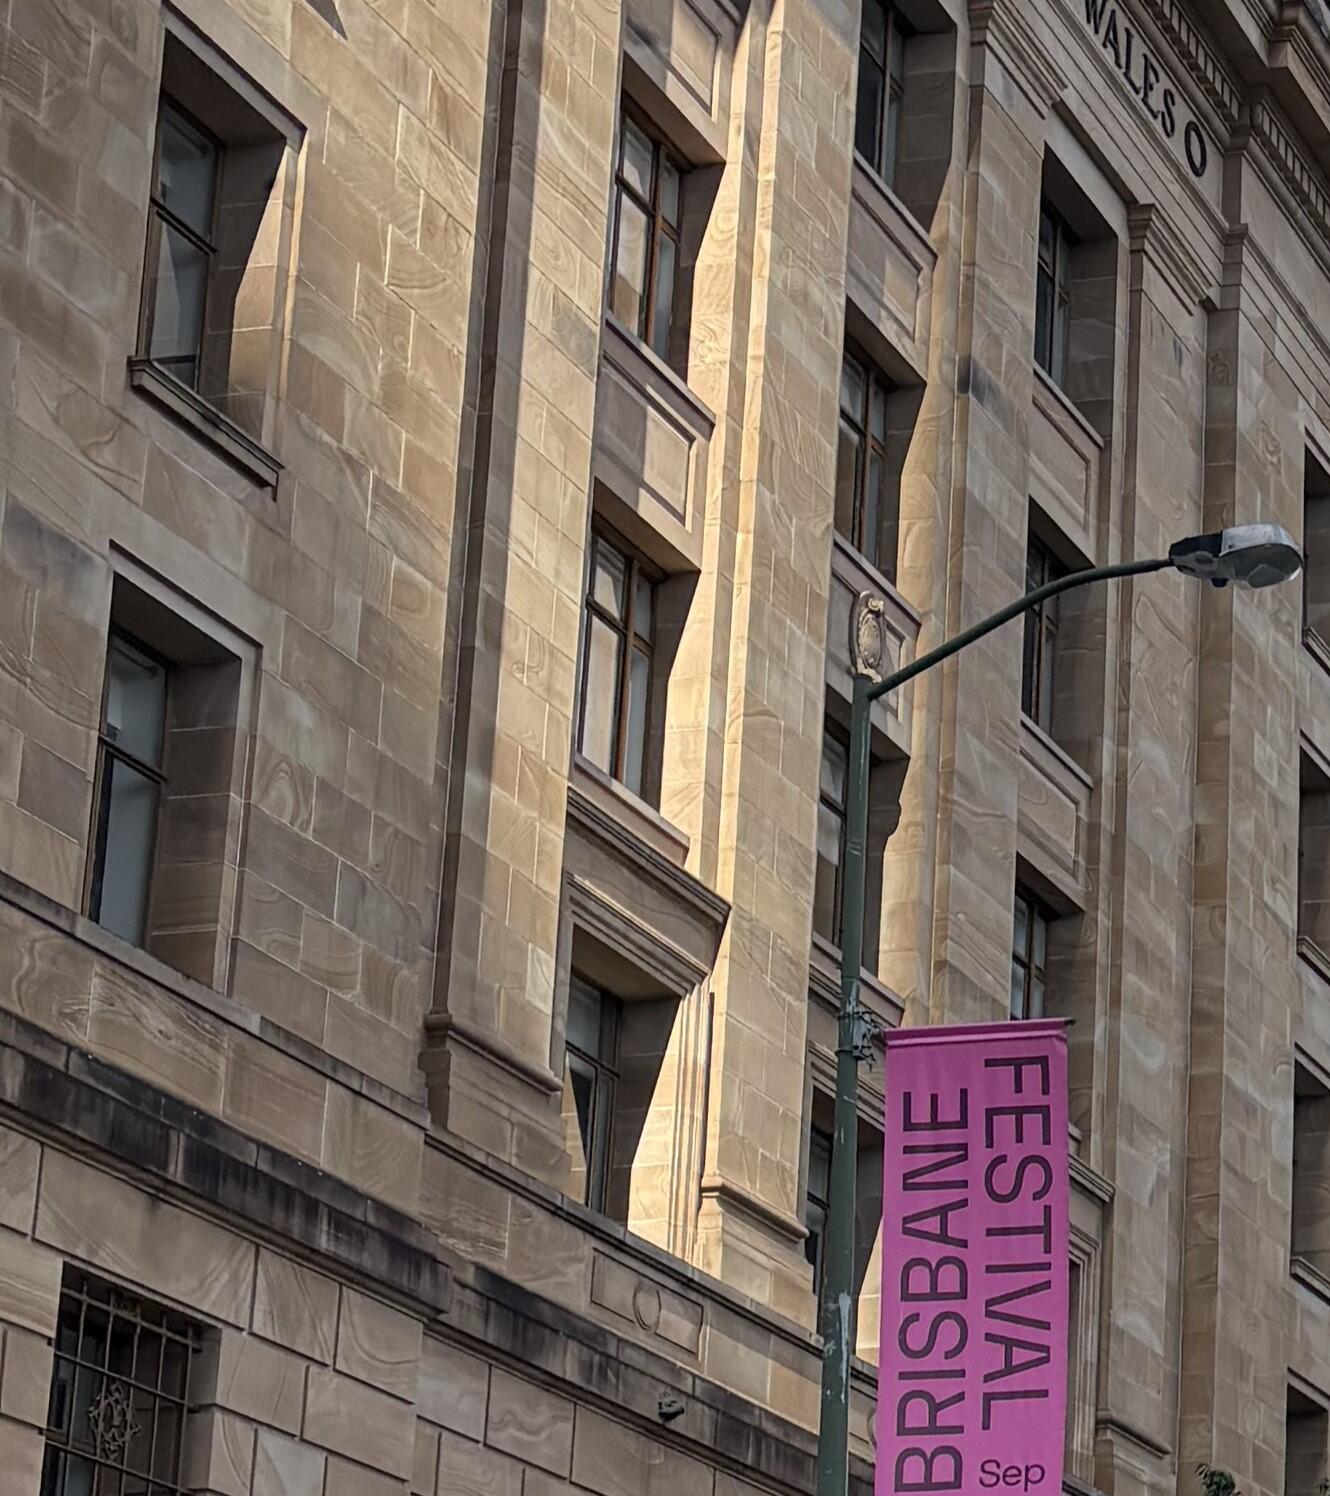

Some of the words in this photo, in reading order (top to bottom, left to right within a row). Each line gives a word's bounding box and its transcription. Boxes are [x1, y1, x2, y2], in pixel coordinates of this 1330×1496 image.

[894, 1088, 969, 1492] BRISBANE
[981, 1055, 1053, 1431] FESTIVAL
[978, 1459, 1046, 1492] Sep
